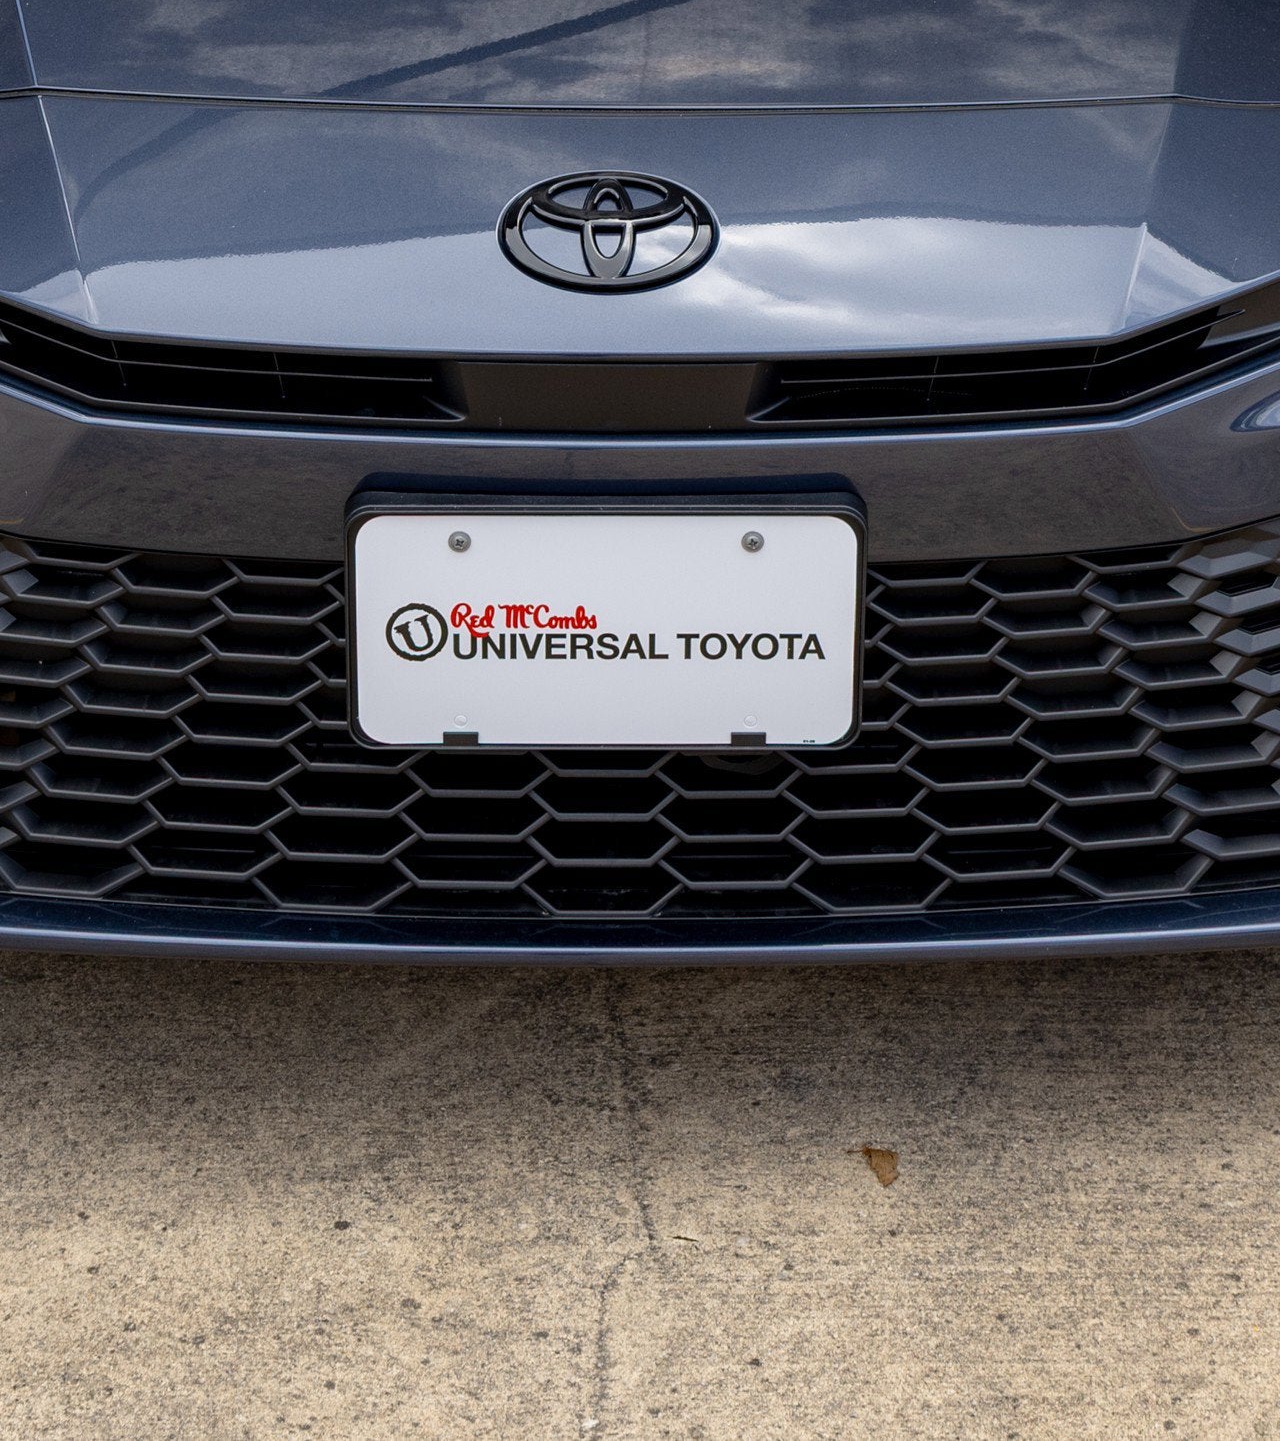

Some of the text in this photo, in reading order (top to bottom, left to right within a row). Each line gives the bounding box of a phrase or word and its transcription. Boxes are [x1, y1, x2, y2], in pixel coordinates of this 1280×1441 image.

[450, 602, 598, 638] Red McCombs
[452, 632, 827, 660] UNIVERSAL TOYOTA
